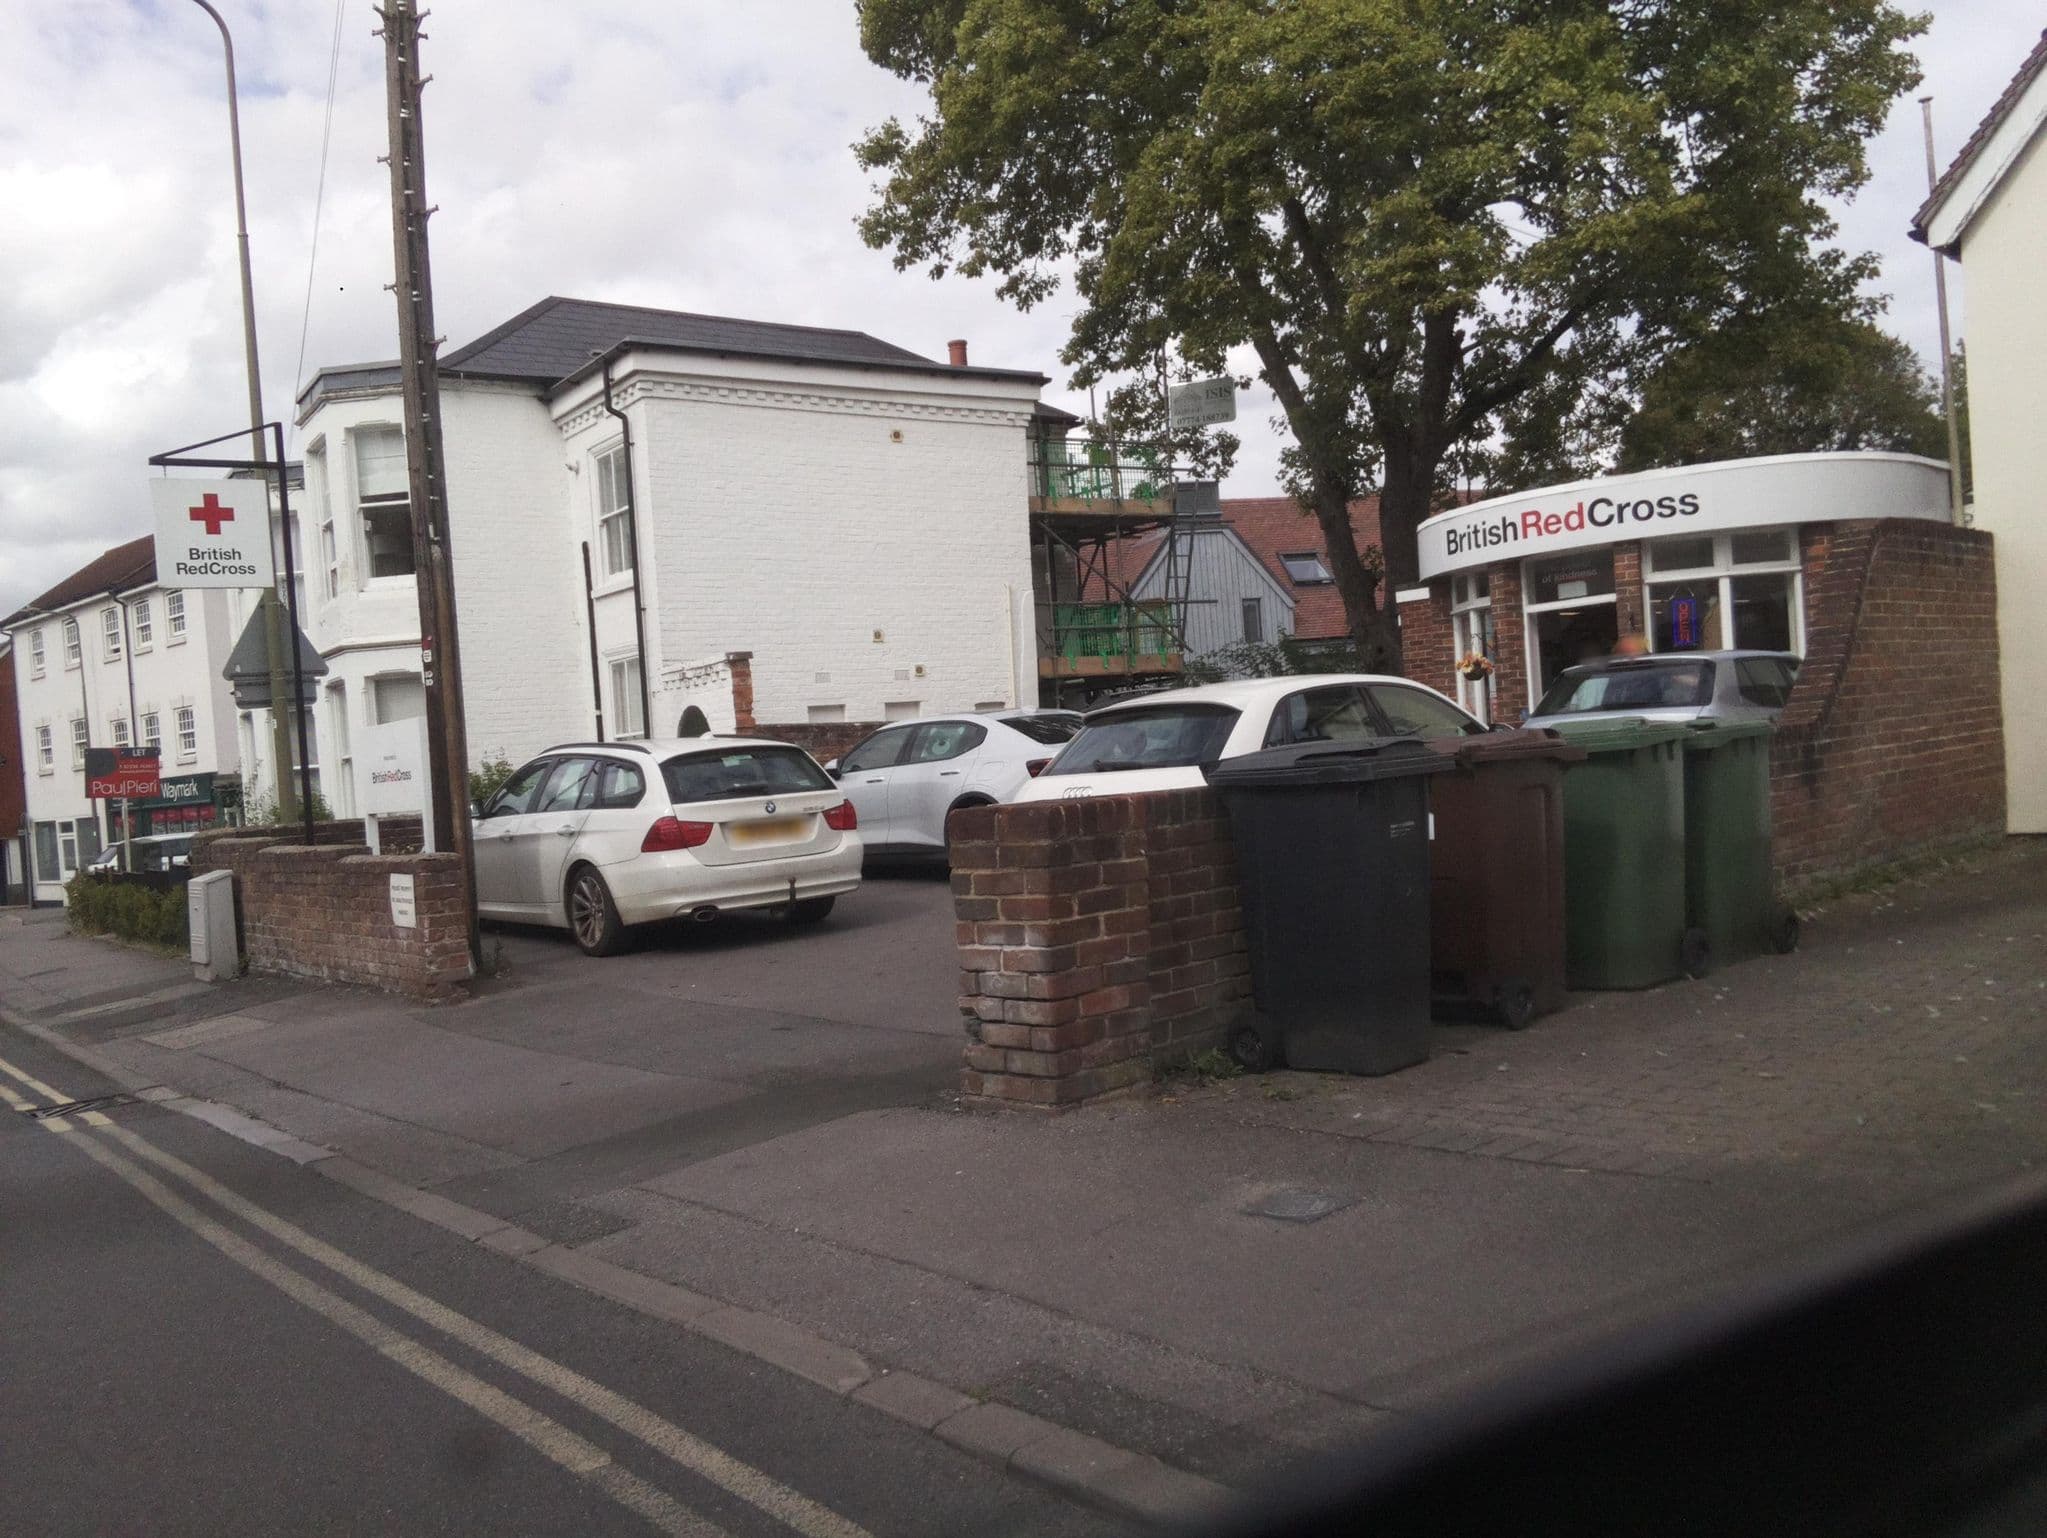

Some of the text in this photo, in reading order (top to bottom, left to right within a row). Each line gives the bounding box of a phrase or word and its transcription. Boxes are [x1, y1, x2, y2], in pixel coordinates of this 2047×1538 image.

[1206, 386, 1232, 399] ISIS
[1446, 493, 1700, 556] BritishRedCross
[189, 547, 242, 561] British
[176, 562, 256, 576] RedCross
[132, 749, 146, 757] LET
[160, 778, 199, 802] Waymark
